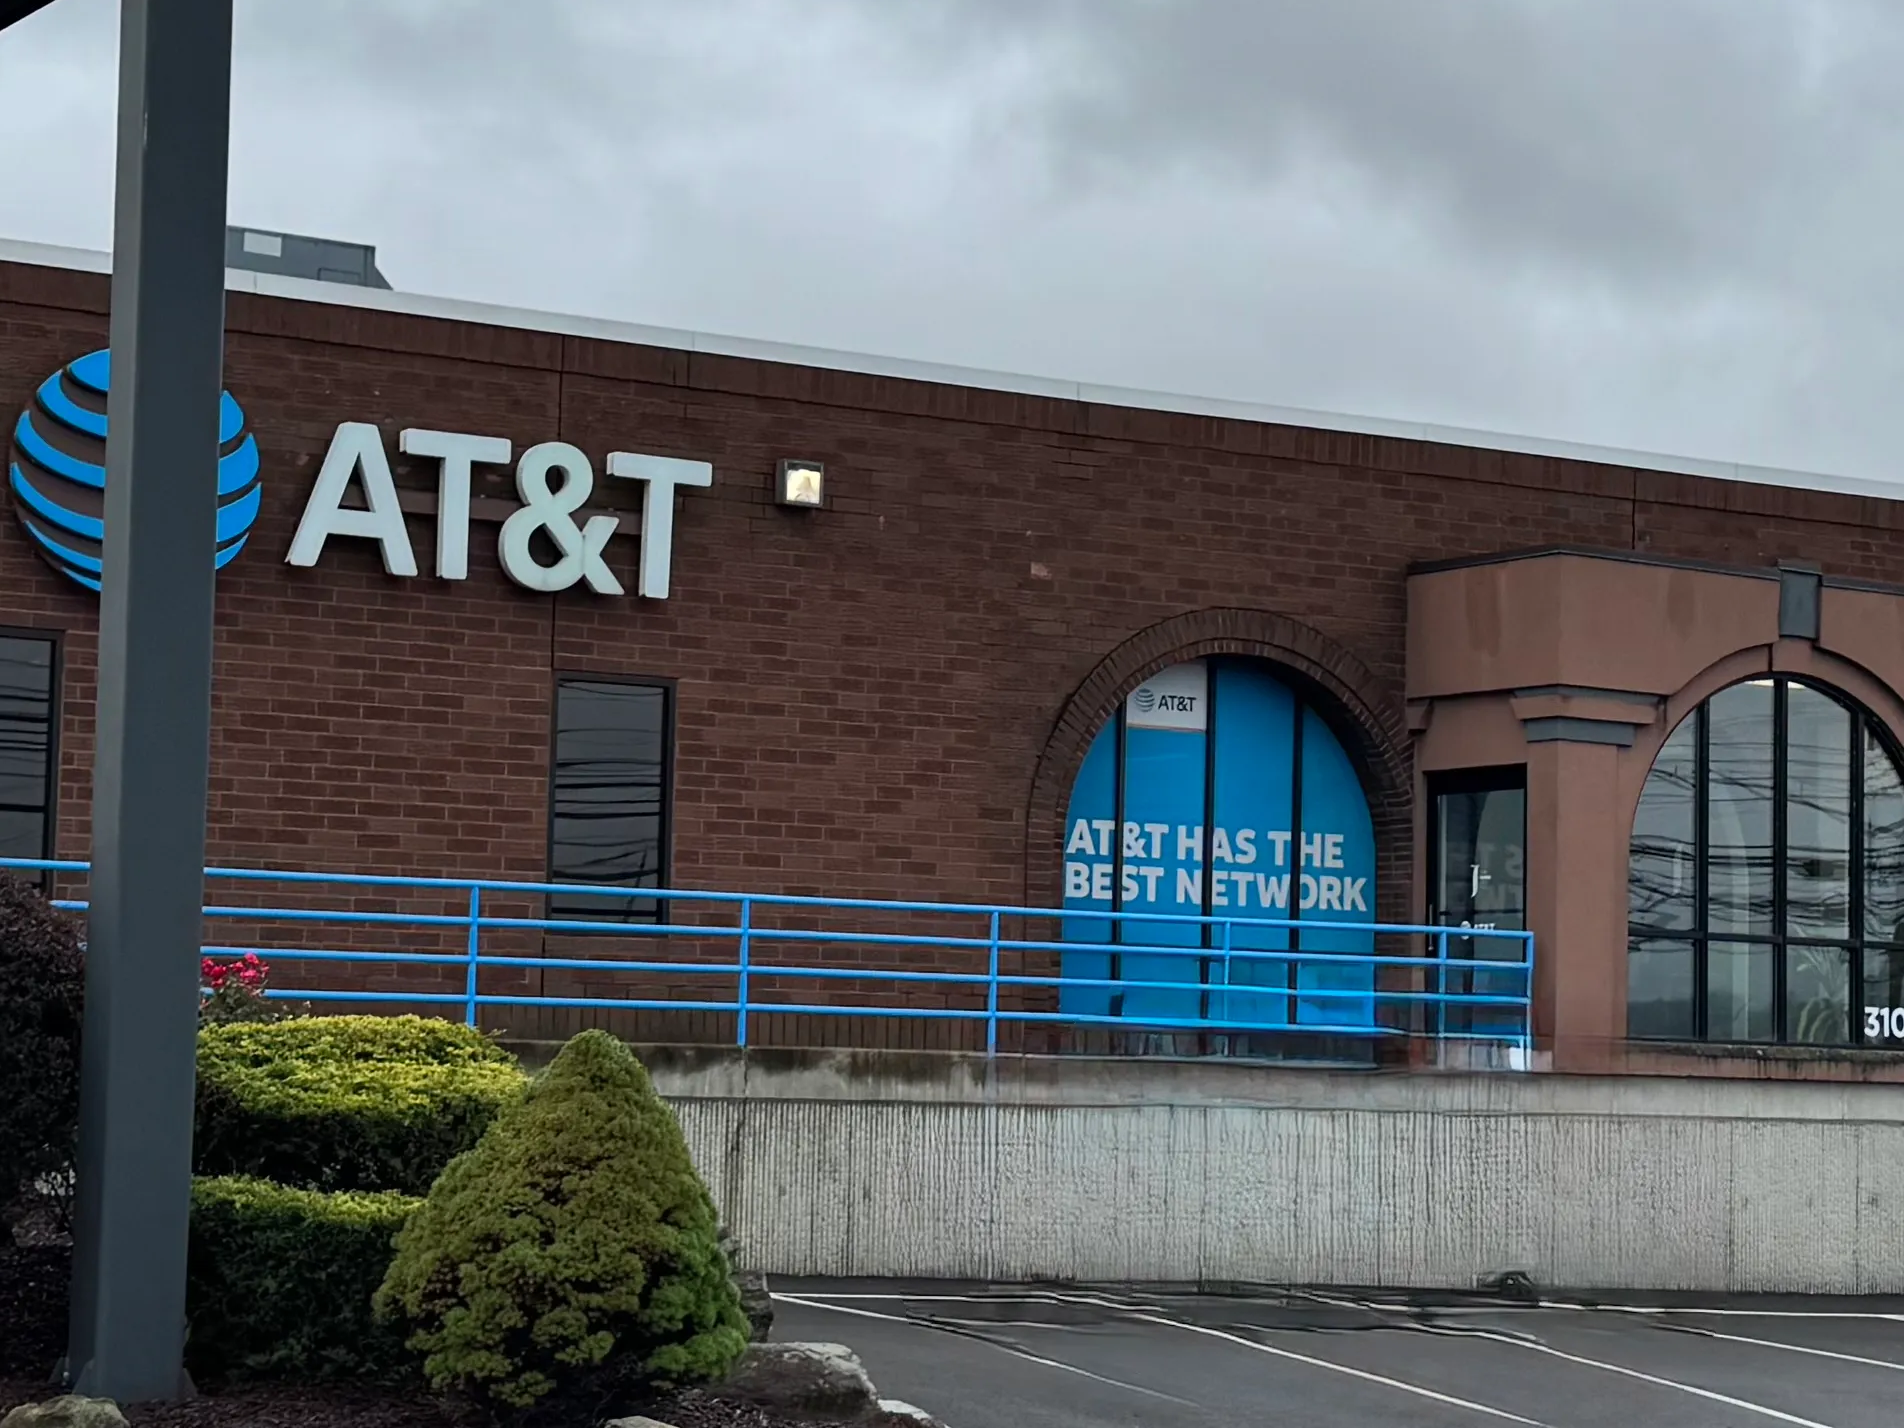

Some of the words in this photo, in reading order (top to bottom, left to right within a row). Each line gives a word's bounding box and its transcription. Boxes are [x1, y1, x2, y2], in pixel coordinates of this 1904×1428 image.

[284, 421, 712, 600] AT&T
[1157, 694, 1197, 713] AT&T
[1065, 818, 1169, 859] AT&T
[1176, 824, 1257, 864] HAS
[1267, 830, 1345, 869] THE
[1064, 861, 1165, 903] BEST
[1176, 868, 1367, 912] NETWORK
